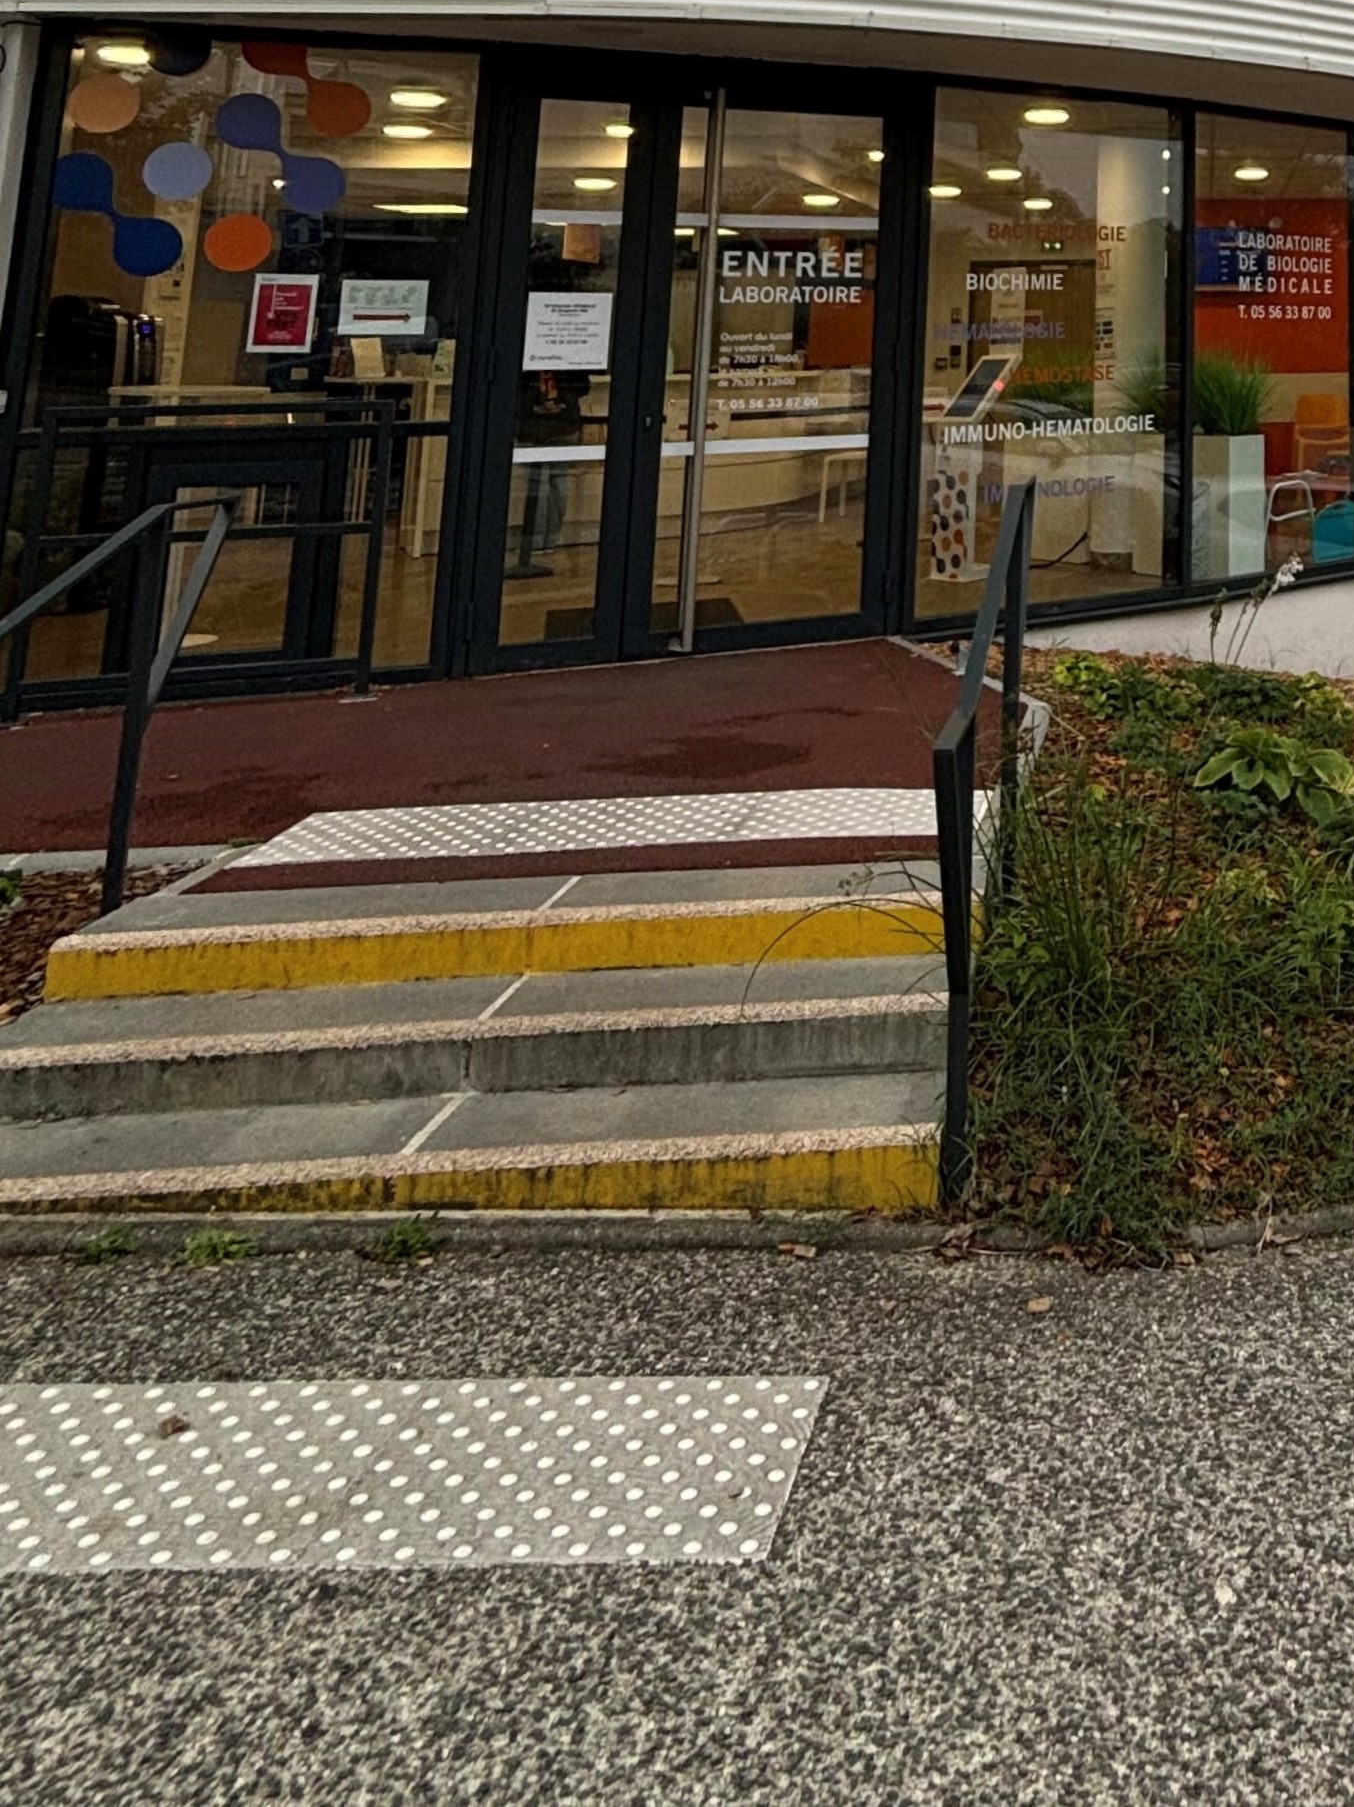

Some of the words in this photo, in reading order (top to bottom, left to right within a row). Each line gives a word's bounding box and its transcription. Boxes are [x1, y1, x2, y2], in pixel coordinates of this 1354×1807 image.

[1238, 231, 1333, 253] LABORATOIRE
[722, 246, 864, 278] ENTRÉE
[1239, 254, 1258, 271] DE
[1267, 255, 1333, 274] BIOLOGIE
[966, 272, 1065, 291] BIOCHIMIE
[1238, 273, 1333, 295] MÉDICALE
[719, 286, 862, 304] LABORATOIRE
[1238, 305, 1248, 319] T.
[1250, 305, 1265, 319] 05
[1269, 305, 1282, 319] 56
[1285, 305, 1298, 319] 33
[1301, 306, 1315, 319] 87
[1317, 306, 1332, 320] 00
[720, 332, 752, 341] Ouvert
[944, 414, 1156, 444] IMMUNO-HEMATOLOGIE
[984, 475, 1116, 504] IMNOLOGIE
